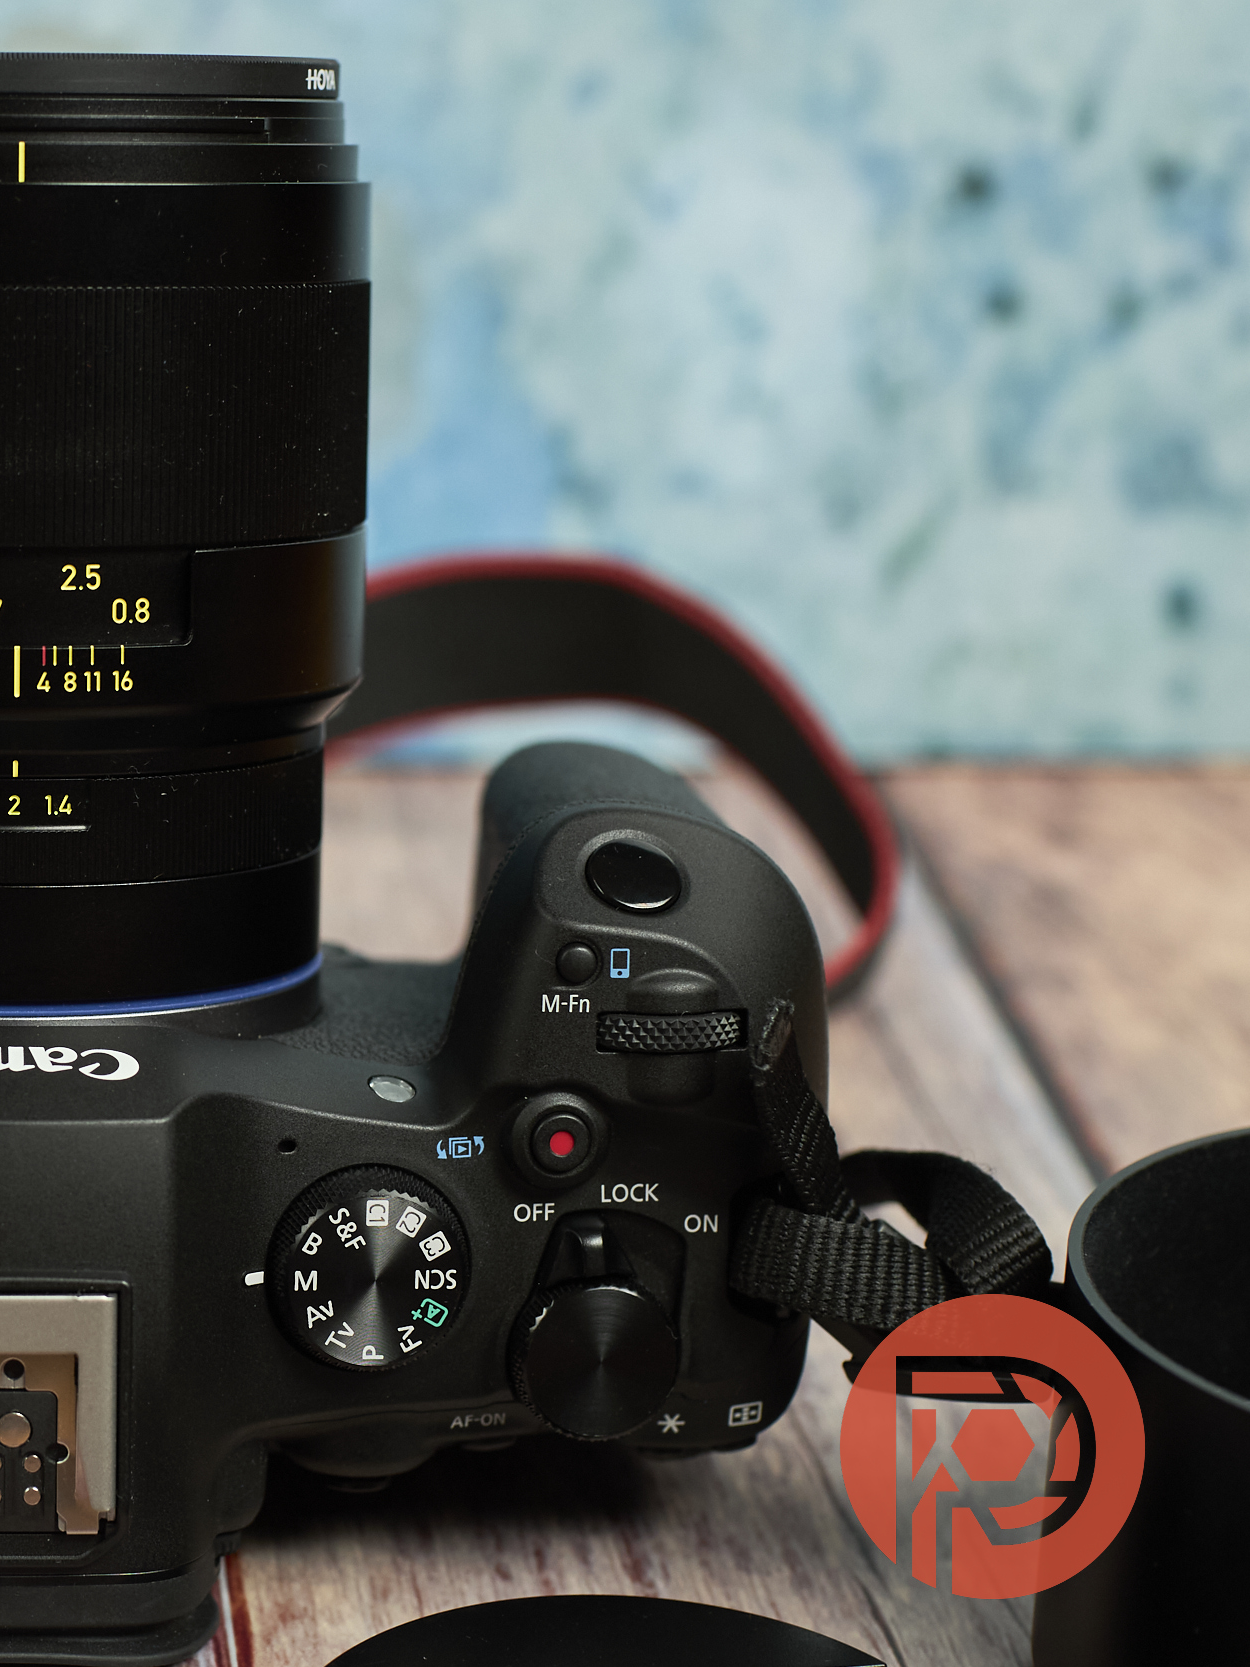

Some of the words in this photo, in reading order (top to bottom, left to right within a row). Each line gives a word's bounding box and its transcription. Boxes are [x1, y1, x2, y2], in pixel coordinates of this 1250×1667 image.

[305, 68, 336, 91] HOYA
[60, 563, 101, 591] 2.5
[111, 597, 151, 625] 0.8
[36, 671, 51, 693] 4
[63, 671, 78, 693] 8
[83, 670, 101, 693] 11
[112, 670, 134, 692] 16
[7, 794, 21, 816] 2
[44, 794, 73, 816] 1.4
[541, 994, 591, 1013] M-Fn
[600, 1183, 659, 1204] LOCK
[367, 1202, 388, 1225] C1
[398, 1208, 424, 1236] C2
[513, 1203, 555, 1223] OFF
[683, 1214, 718, 1234] ON
[328, 1207, 367, 1250] S&F
[301, 1232, 323, 1256] B
[421, 1233, 448, 1260] C3
[294, 1270, 318, 1292] M
[414, 1269, 457, 1290] SCN
[306, 1300, 334, 1329] Av
[325, 1321, 355, 1349] Tv
[397, 1325, 423, 1353] Fv
[362, 1345, 385, 1360] P
[450, 1413, 507, 1429] AF-ON
